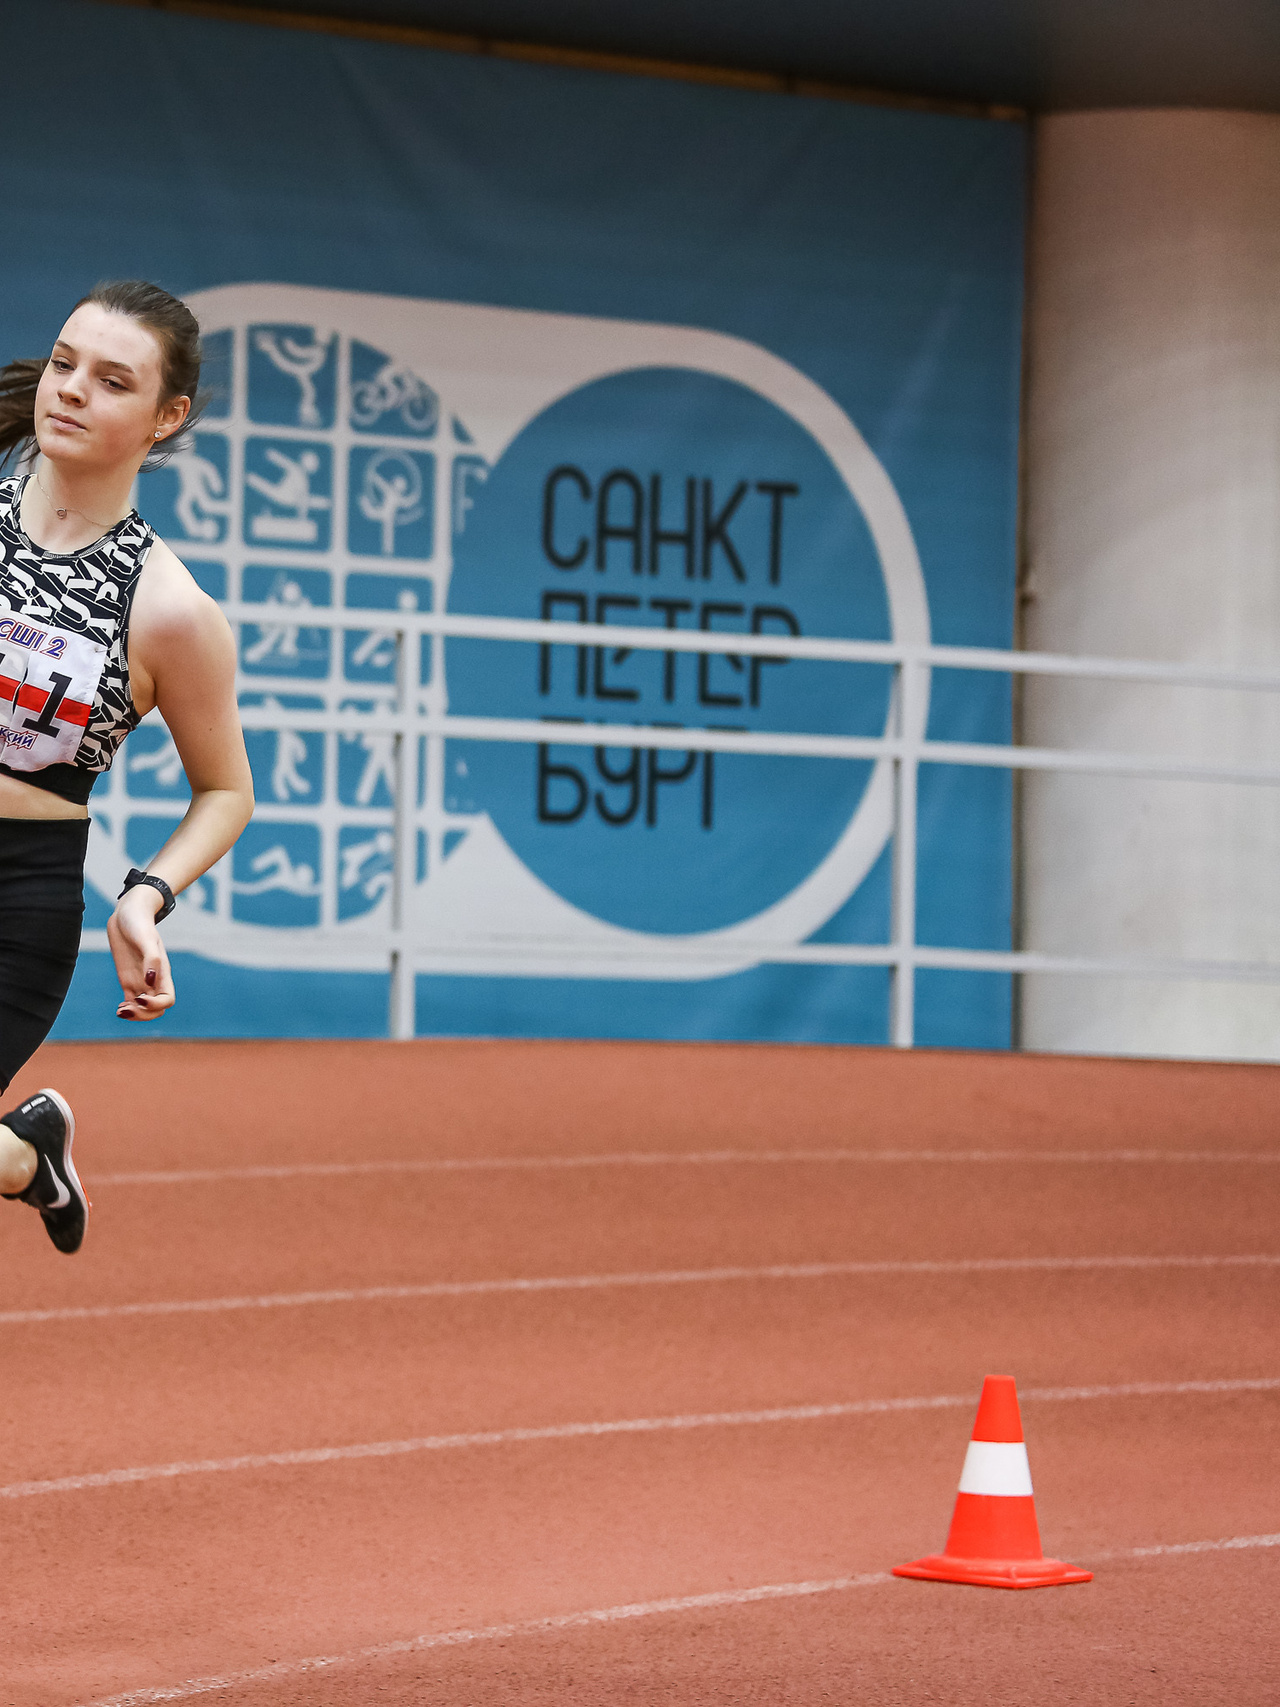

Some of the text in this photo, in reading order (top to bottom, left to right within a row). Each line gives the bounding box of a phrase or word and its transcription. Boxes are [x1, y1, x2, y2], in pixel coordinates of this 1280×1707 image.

[542, 463, 800, 587] САНКТ
[41, 636, 68, 660] 2
[539, 590, 801, 709] ПЕТЕР
